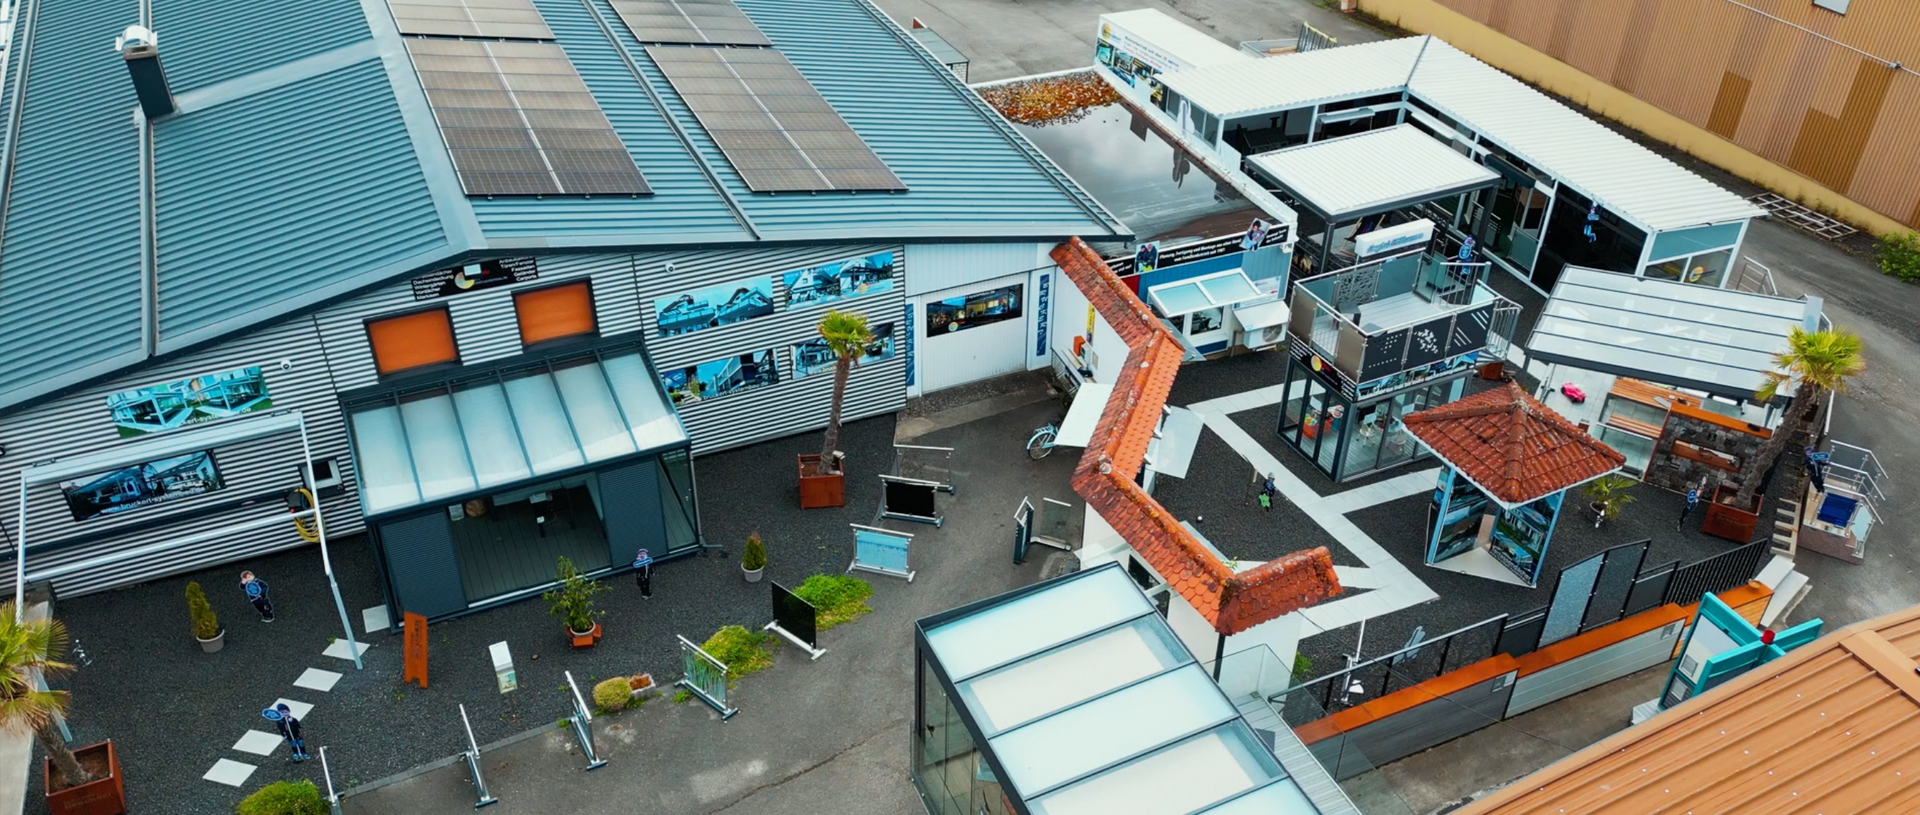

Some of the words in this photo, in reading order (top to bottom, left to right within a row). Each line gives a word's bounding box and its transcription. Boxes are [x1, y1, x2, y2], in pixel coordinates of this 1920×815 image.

[414, 281, 447, 290] Wintergärten
[415, 287, 441, 295] Vordächer
[101, 486, 205, 513] www.bruckert-systembau.de
